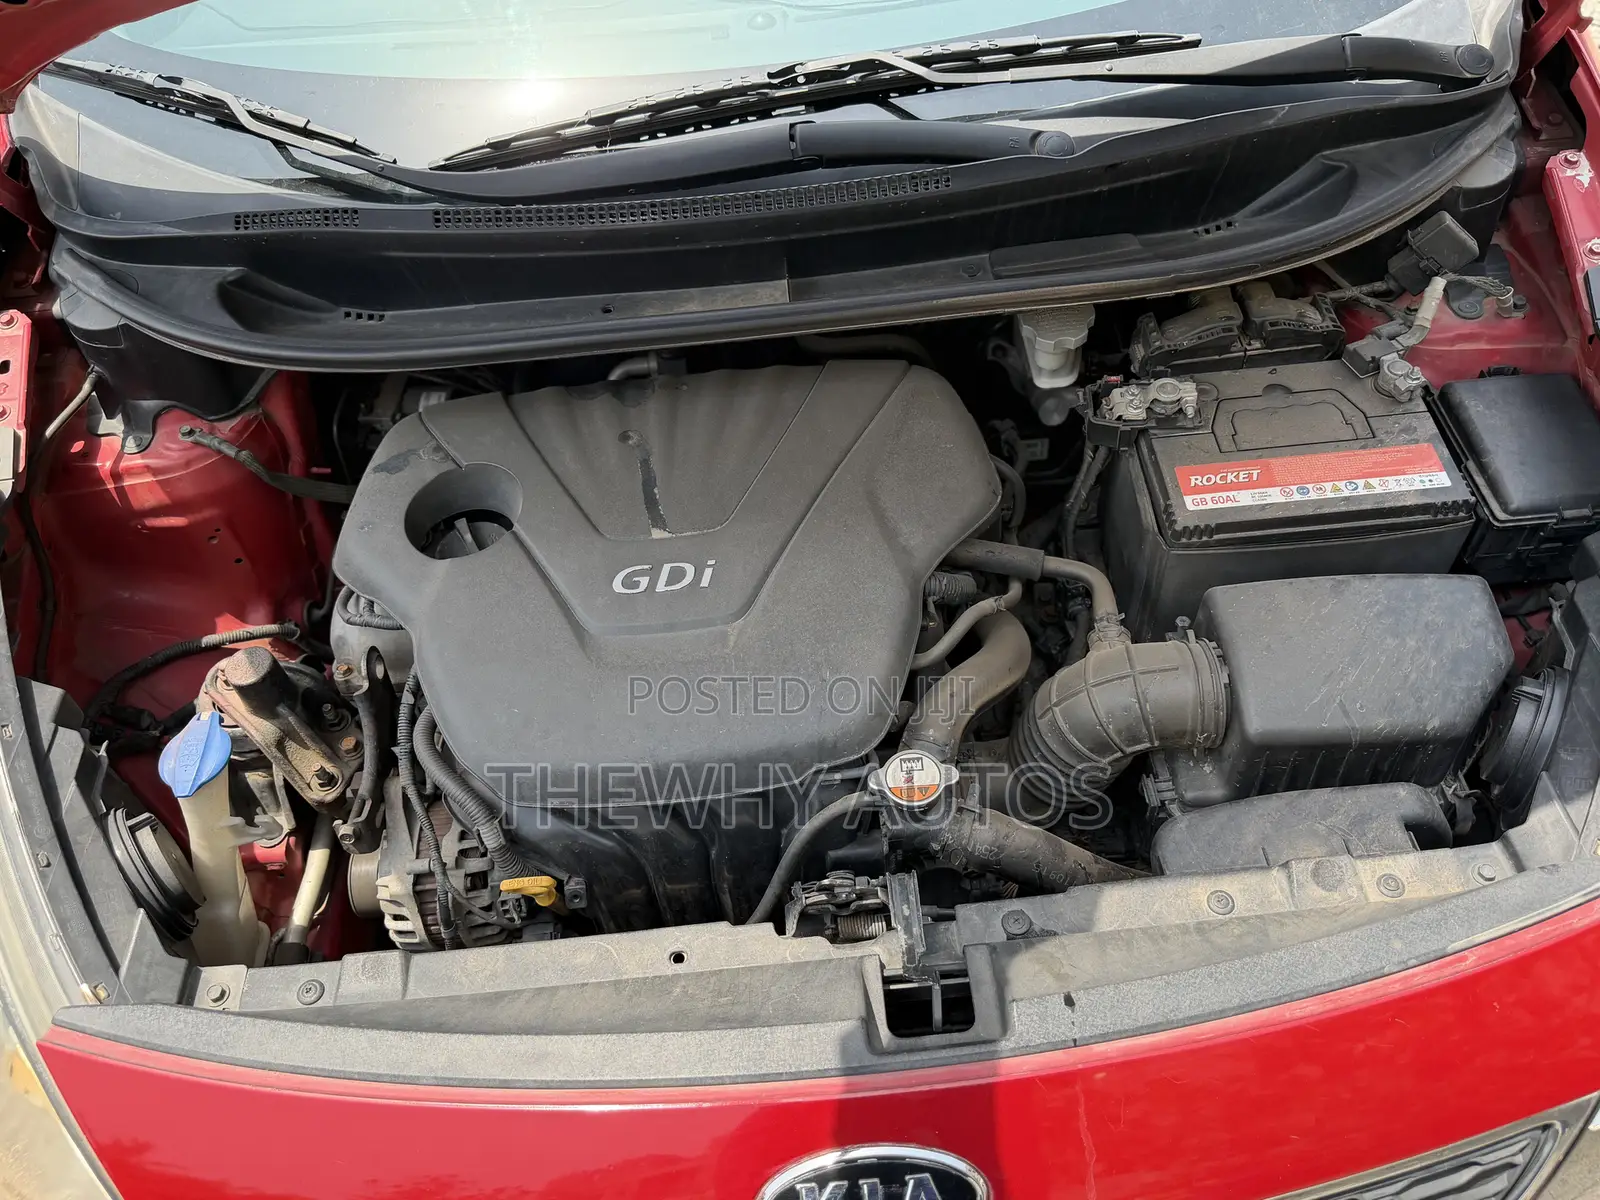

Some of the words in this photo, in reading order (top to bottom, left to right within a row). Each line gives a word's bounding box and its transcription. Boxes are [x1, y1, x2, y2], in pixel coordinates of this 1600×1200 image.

[1189, 469, 1261, 487] ROCKET
[1191, 498, 1208, 507] GB
[1211, 494, 1241, 505] 60AL
[612, 559, 717, 594] GDi
